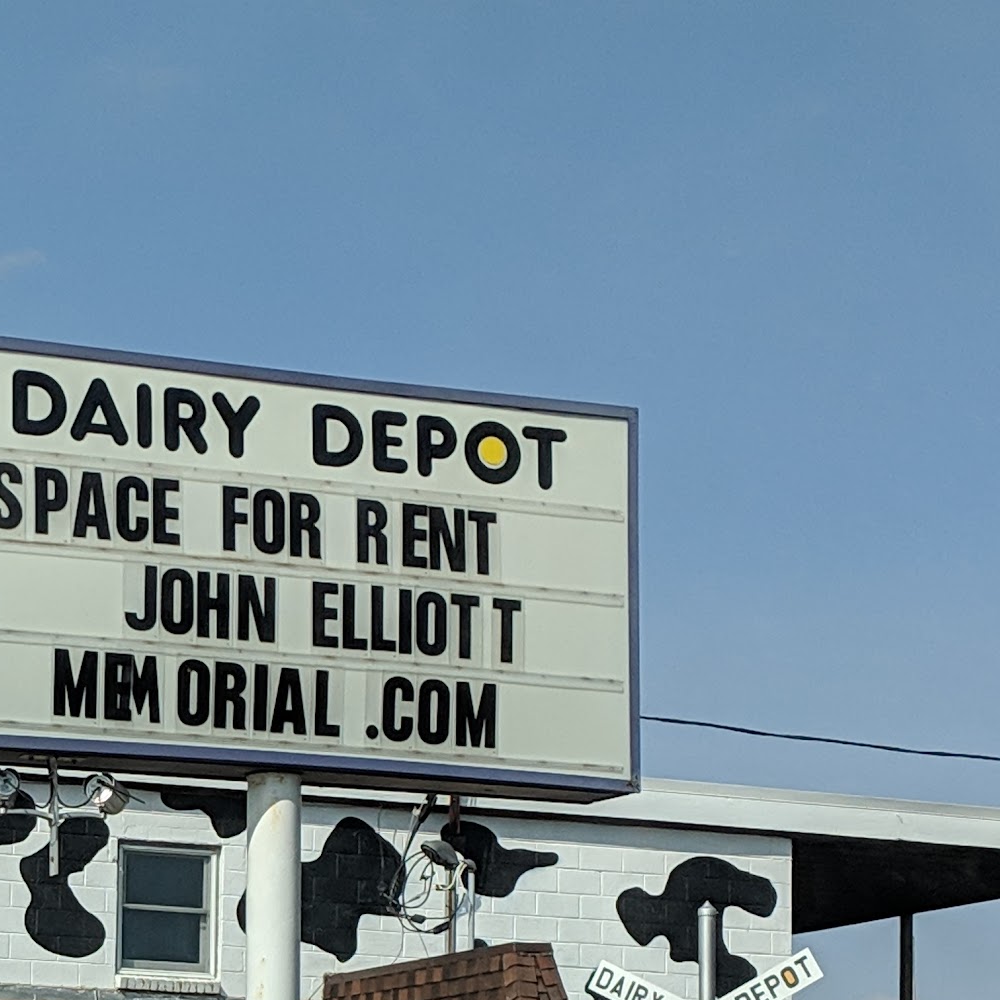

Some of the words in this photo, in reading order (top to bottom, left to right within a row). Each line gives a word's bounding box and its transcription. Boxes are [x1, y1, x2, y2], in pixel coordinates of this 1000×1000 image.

[12, 369, 260, 459] DAIRY
[312, 403, 567, 490] DEPOT
[222, 485, 321, 559] FOR
[357, 498, 497, 575] RENT
[125, 565, 276, 643] JOHN
[312, 581, 522, 664] ELLIOTT
